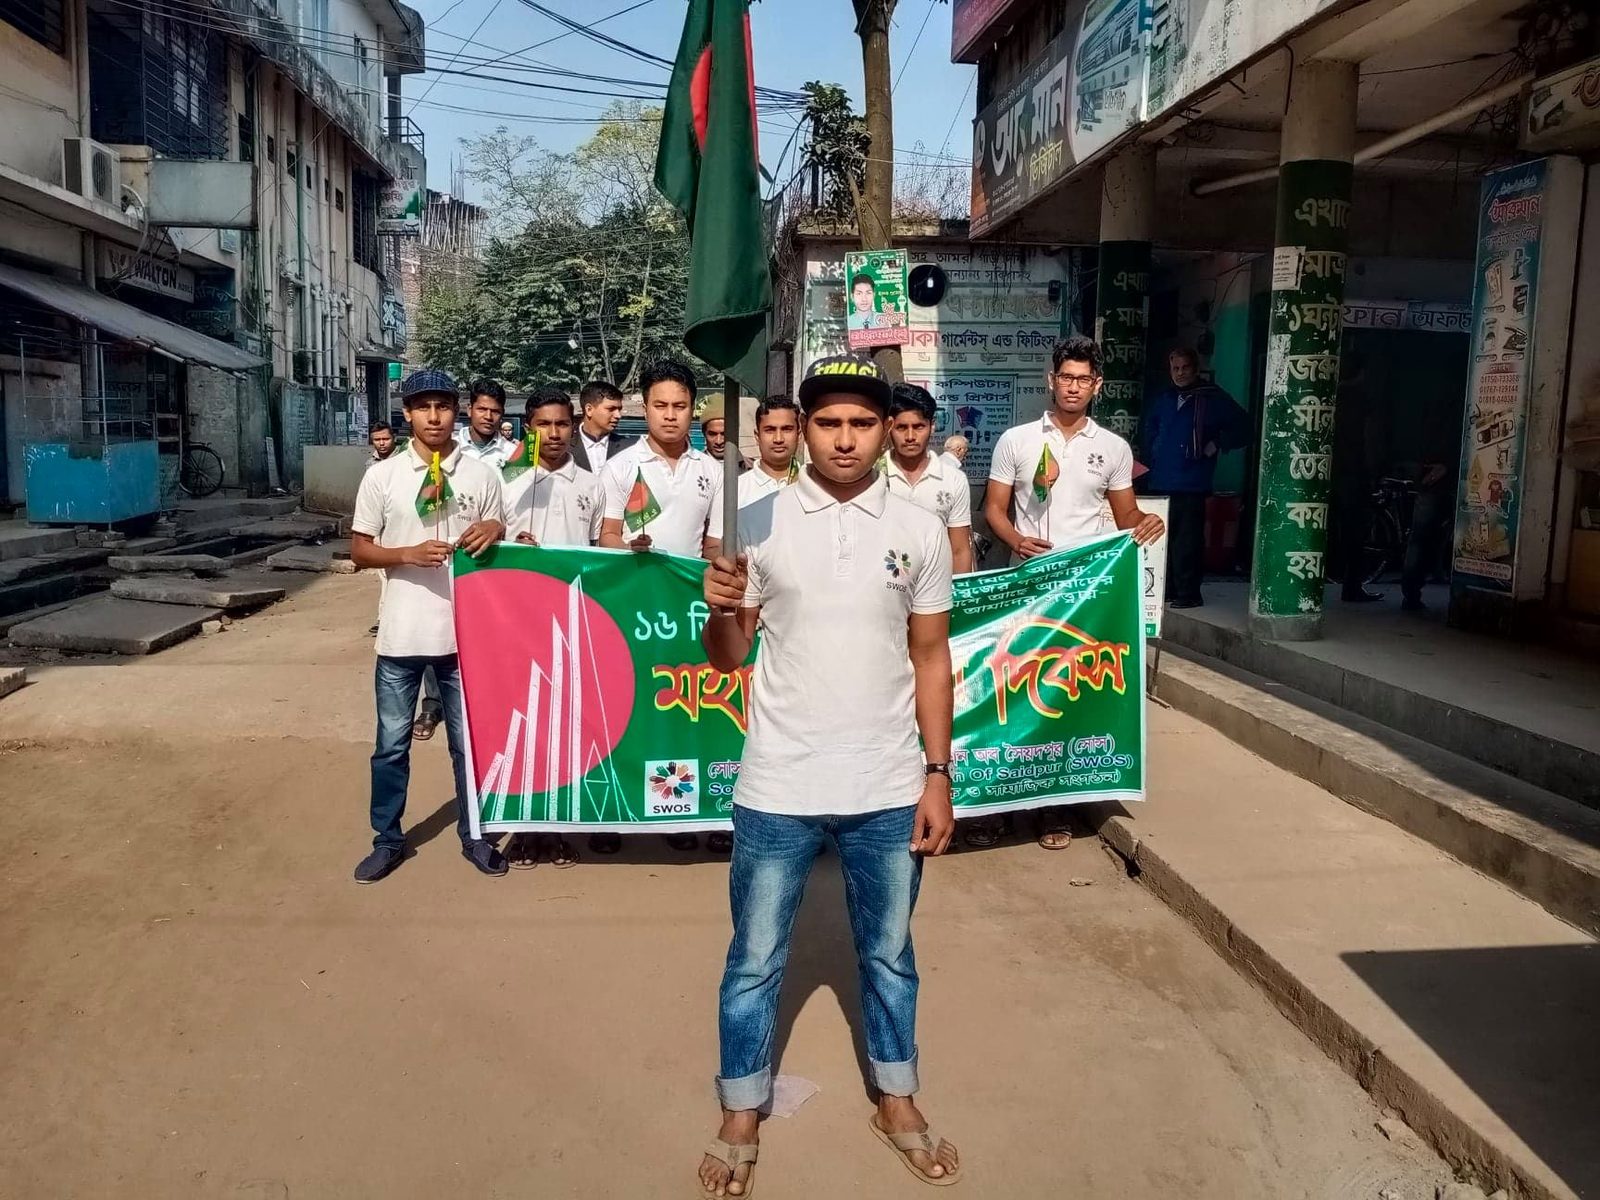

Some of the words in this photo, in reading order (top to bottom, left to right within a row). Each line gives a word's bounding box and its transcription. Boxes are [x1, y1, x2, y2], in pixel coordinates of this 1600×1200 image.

[1286, 502, 1329, 529] করা
[634, 610, 678, 641] ১৬
[985, 615, 1129, 725] দিবস
[969, 767, 993, 783] Of
[996, 762, 1062, 781] Saidpur
[1065, 754, 1134, 773] (SWOS)
[652, 803, 691, 815] SWOS
